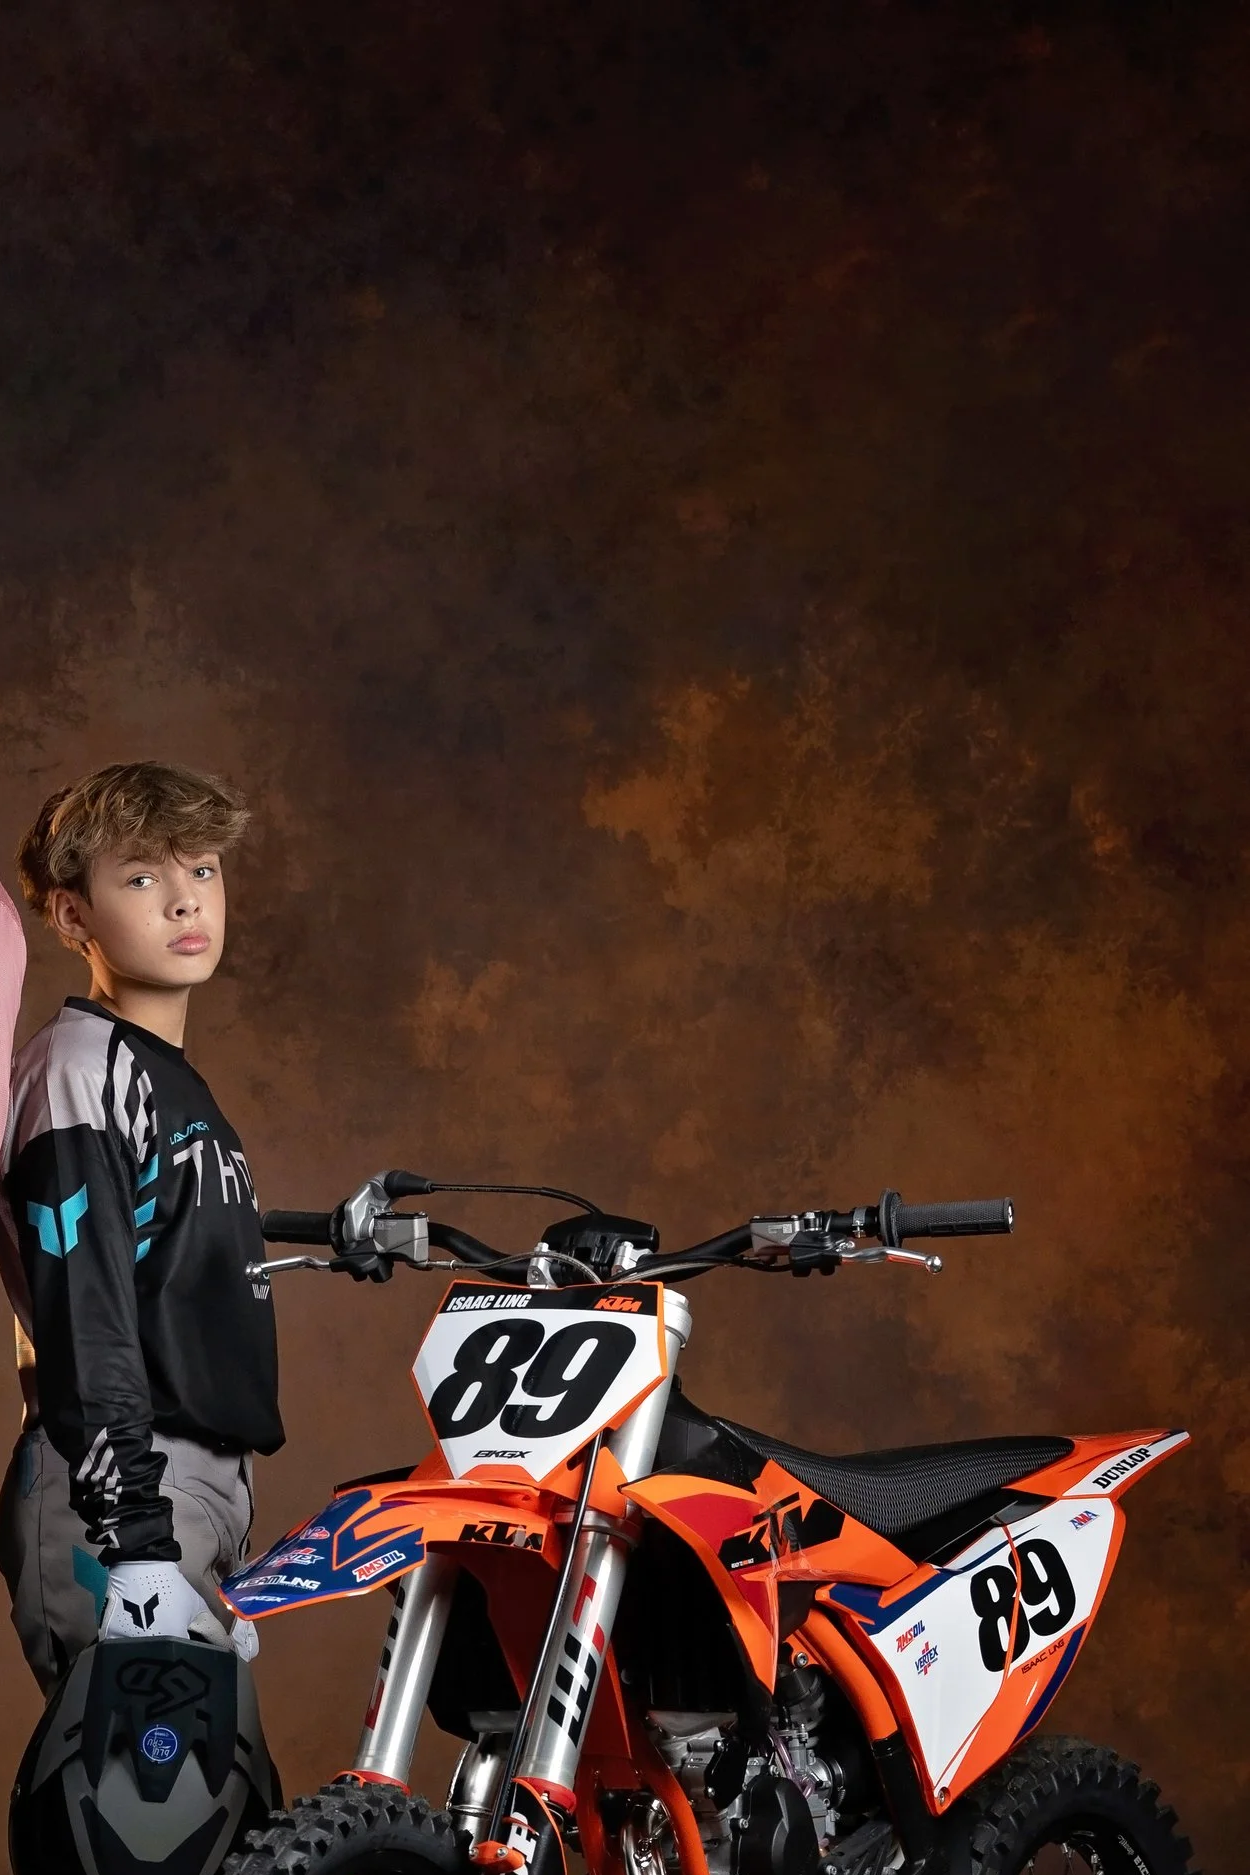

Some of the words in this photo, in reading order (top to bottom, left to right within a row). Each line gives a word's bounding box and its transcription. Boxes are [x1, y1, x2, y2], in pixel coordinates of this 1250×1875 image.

[447, 1294, 494, 1312] ISAAC
[494, 1294, 532, 1309] LING
[594, 1296, 642, 1312] KTM
[429, 1318, 636, 1439] 89
[1092, 1447, 1151, 1489] DUNLOP
[1069, 1510, 1100, 1531] AMA
[355, 1551, 404, 1581] AMSOIL
[970, 1538, 1077, 1673] 89
[896, 1620, 926, 1652] AMSOIL
[915, 1645, 939, 1672] VERTEX
